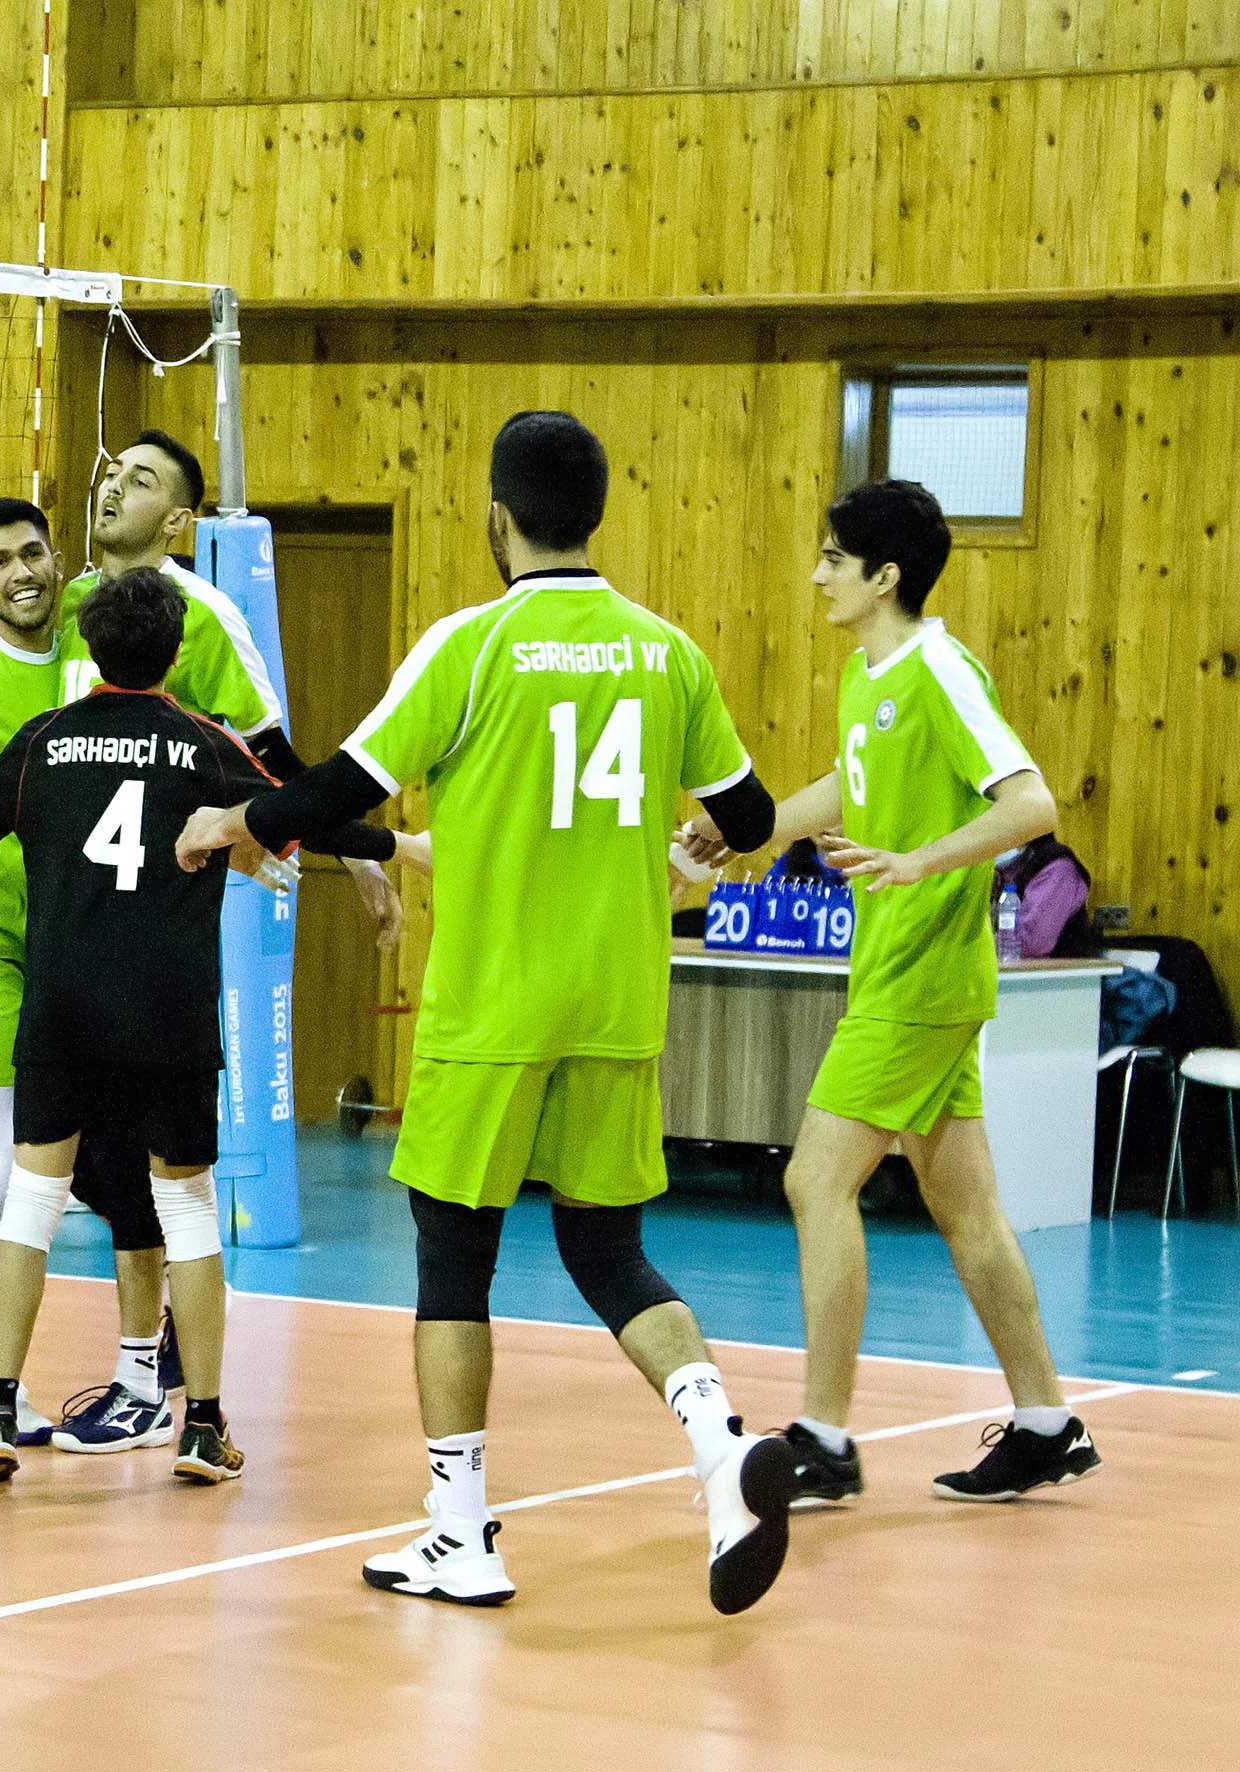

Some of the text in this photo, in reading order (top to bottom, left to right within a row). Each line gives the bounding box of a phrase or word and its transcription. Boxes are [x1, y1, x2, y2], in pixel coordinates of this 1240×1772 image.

[512, 633, 670, 677] SƏRHƏDÇİ VK
[46, 733, 198, 771] SƏRHƏDÇİ VK
[549, 698, 645, 829] 14
[845, 722, 867, 807] 6
[82, 779, 146, 891] 4
[705, 898, 853, 948] 20 1 0 19
[228, 988, 240, 1031] GAMES
[229, 1034, 244, 1102] EUROPEAN
[270, 983, 290, 1122] Baku 2015
